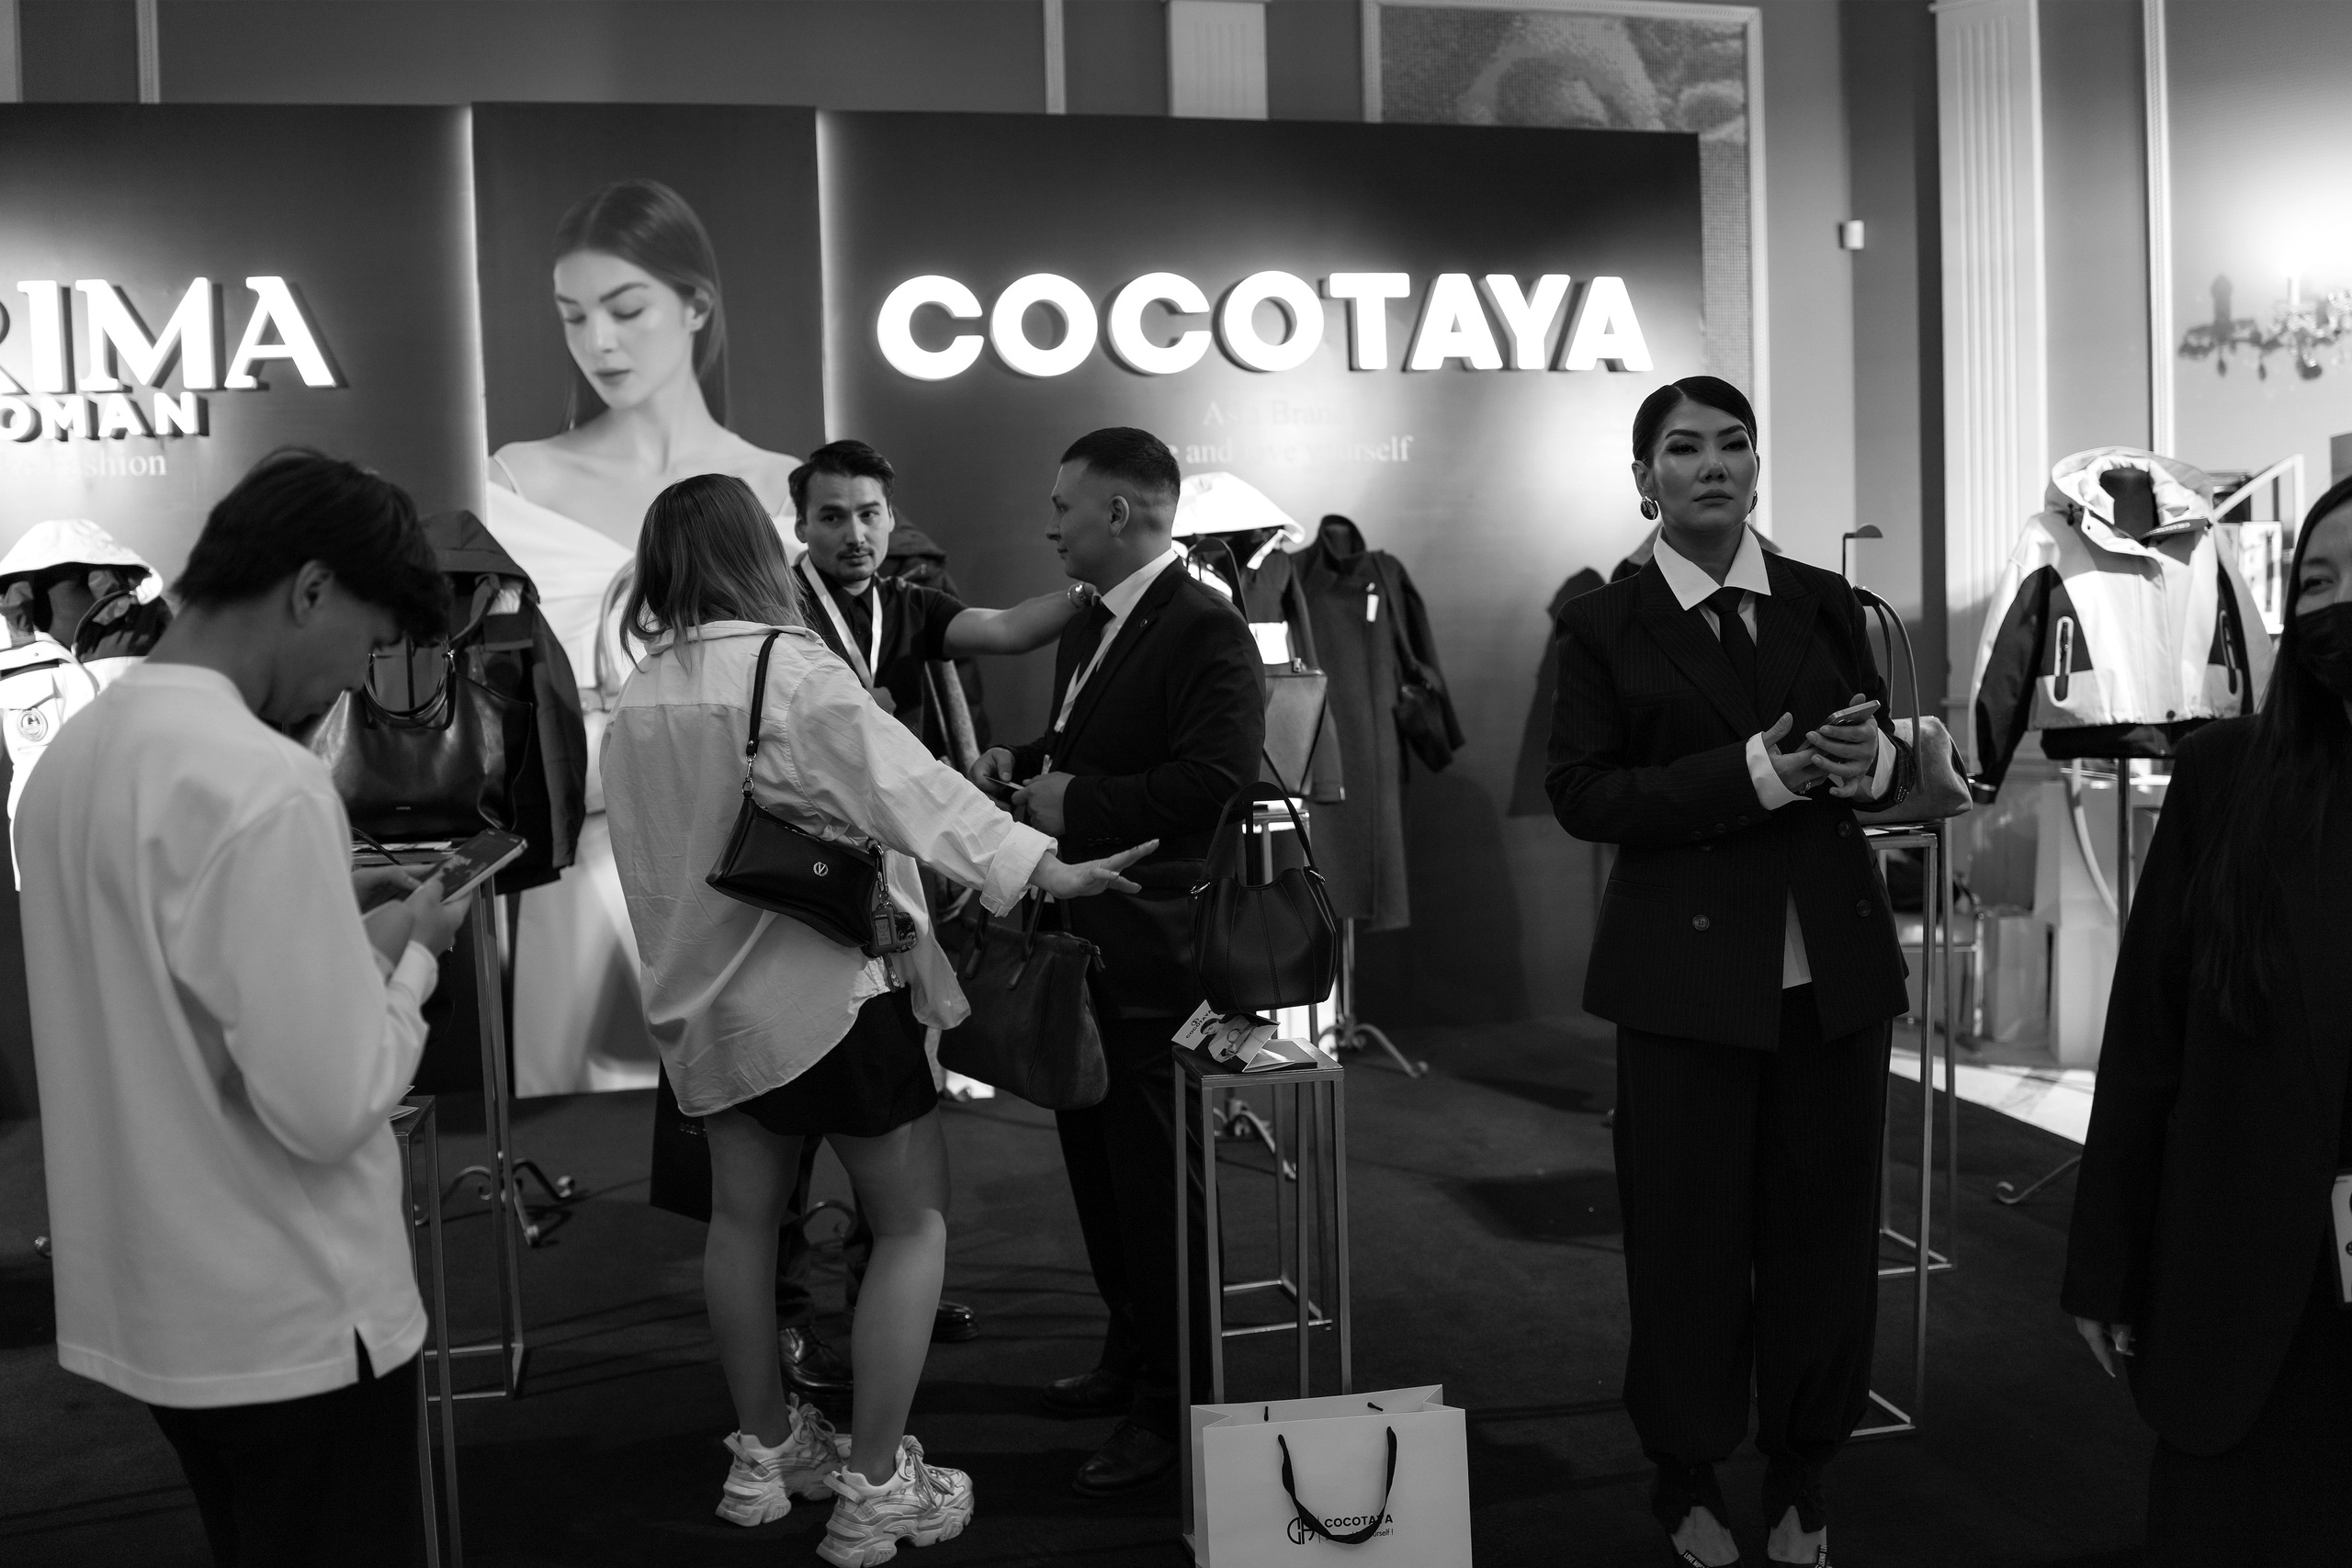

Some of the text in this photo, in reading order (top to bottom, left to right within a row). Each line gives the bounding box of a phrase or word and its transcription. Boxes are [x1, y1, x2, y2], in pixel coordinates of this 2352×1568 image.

[876, 270, 1654, 379] COCOTAYA
[1186, 437, 1233, 463] and
[1374, 1528, 1390, 1537] urself
